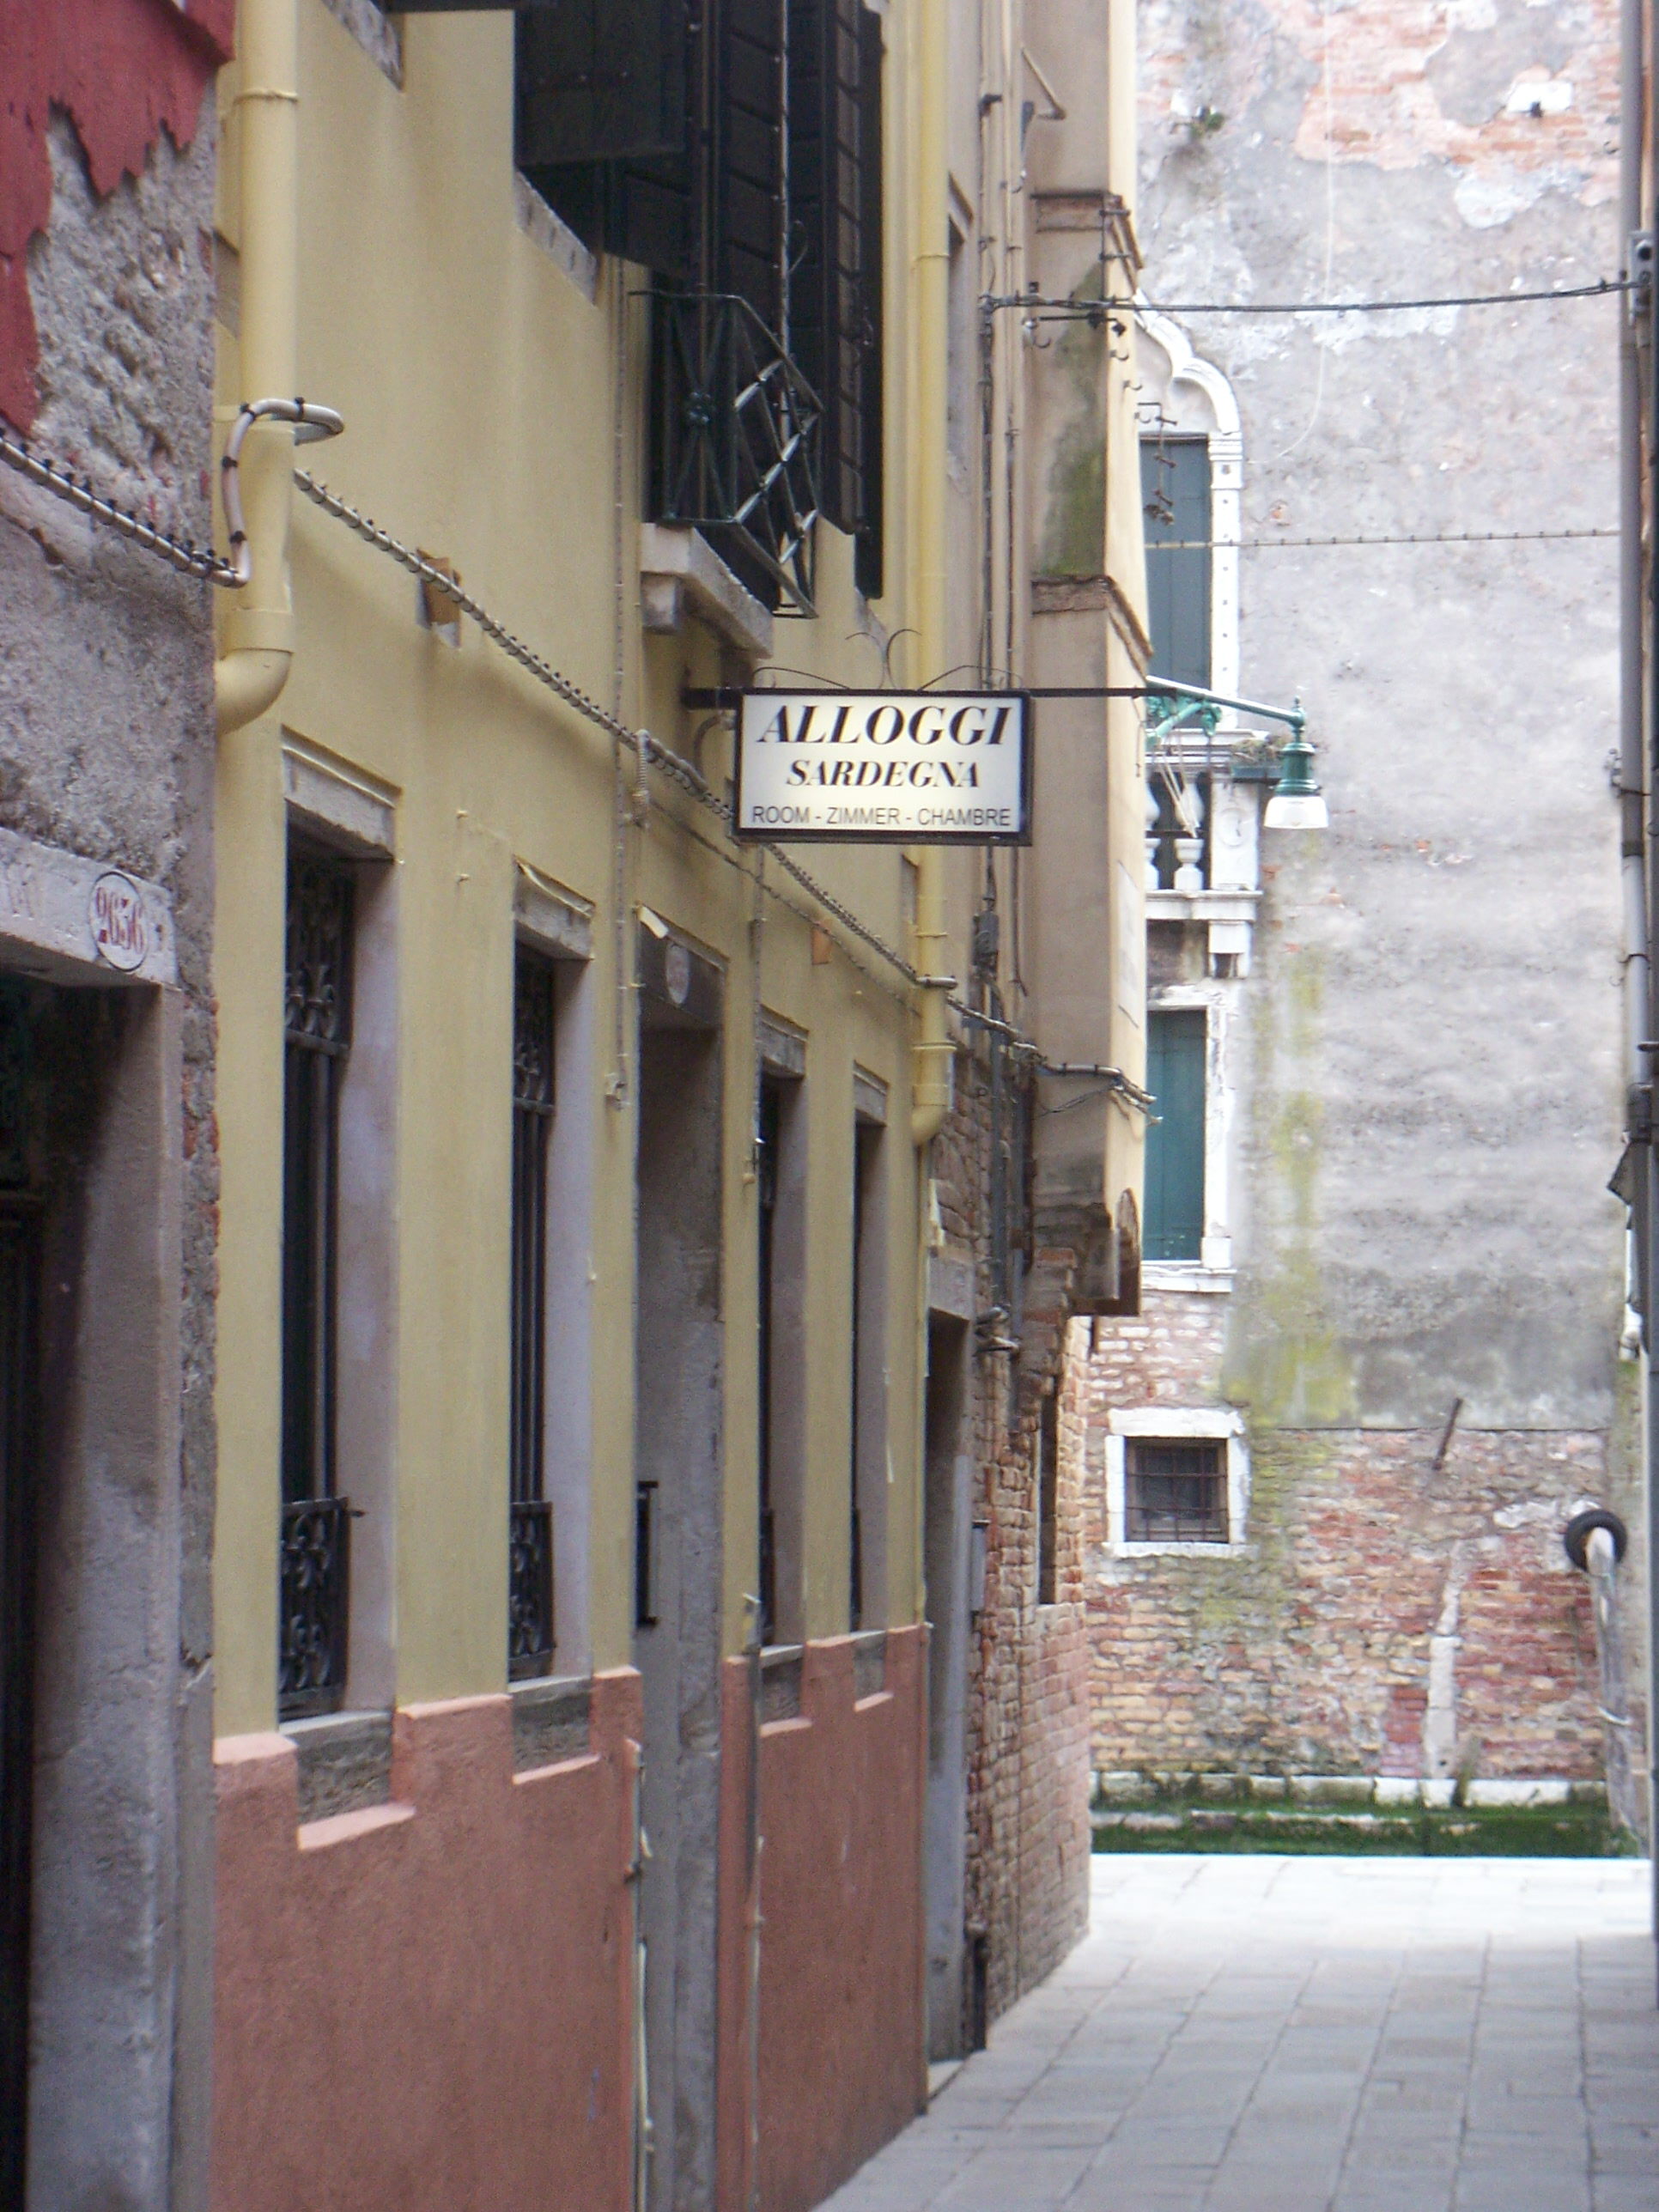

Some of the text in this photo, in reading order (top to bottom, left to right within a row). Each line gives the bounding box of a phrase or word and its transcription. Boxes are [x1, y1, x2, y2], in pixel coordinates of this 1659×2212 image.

[757, 704, 1012, 745] ALLOGGI
[786, 759, 980, 787] SARDEGNA
[751, 805, 811, 824] ROOM
[827, 807, 900, 825] ZIMMER
[918, 809, 1011, 827] CHAMBRE
